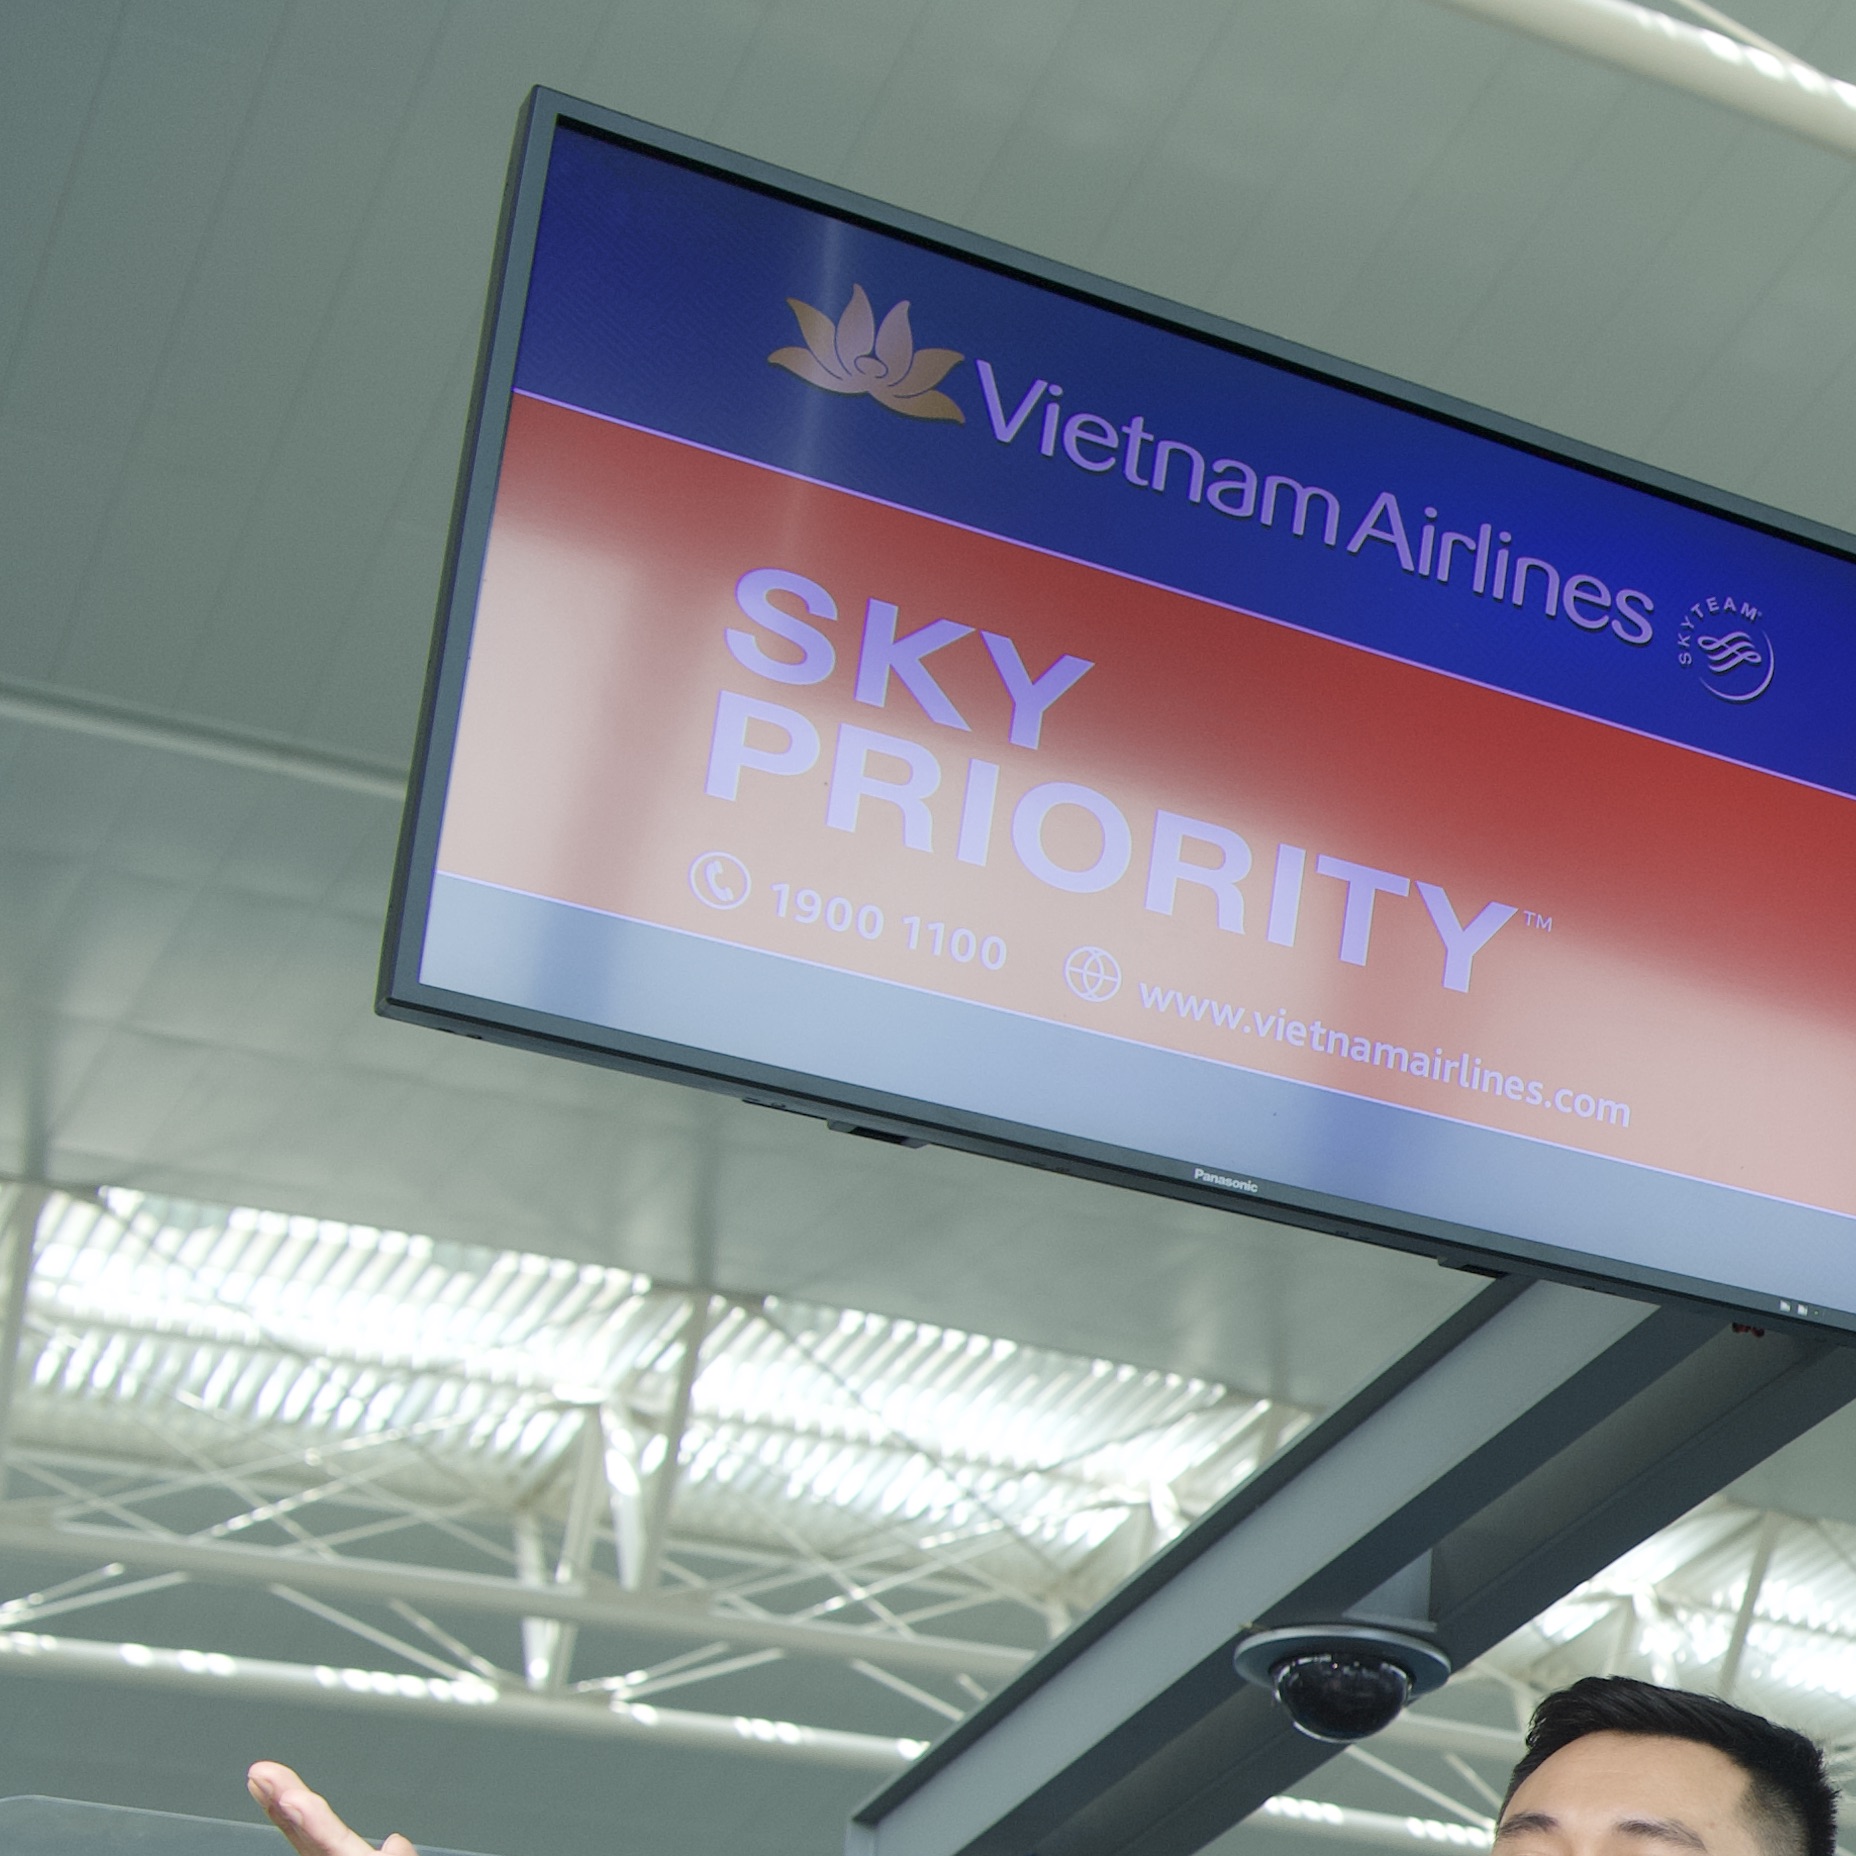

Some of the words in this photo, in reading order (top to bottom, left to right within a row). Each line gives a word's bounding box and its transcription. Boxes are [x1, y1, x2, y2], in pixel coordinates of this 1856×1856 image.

[724, 566, 1096, 751] SKY
[705, 689, 1519, 995] PRIORITY
[770, 882, 885, 941] 1900
[901, 914, 1008, 972] 1100
[1139, 980, 1632, 1129] www.vietnamairlines.com
[1193, 1167, 1259, 1194] Panasonic
